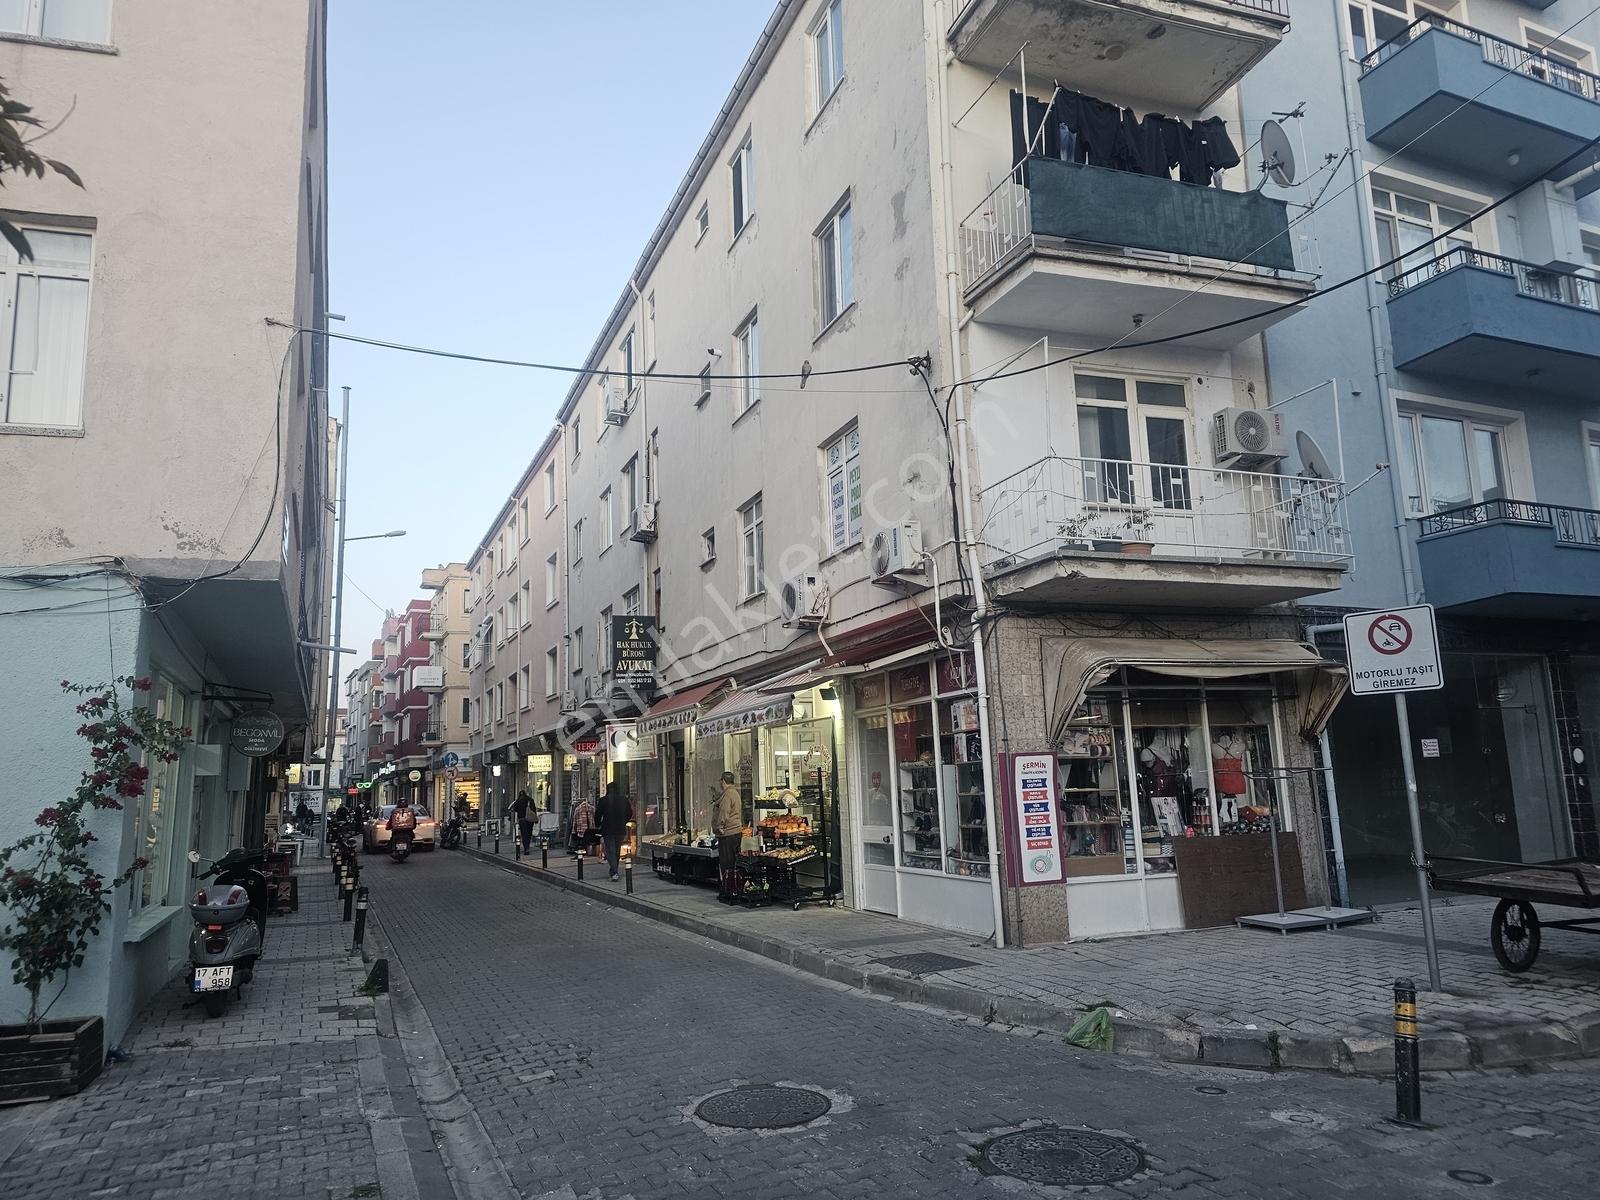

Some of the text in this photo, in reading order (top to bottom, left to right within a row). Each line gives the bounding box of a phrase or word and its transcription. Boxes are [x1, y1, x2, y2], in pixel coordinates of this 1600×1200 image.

[616, 641, 652, 649] HAK HUKUK
[622, 649, 646, 658] BÜROSU
[616, 660, 653, 671] AVUKAT
[1355, 665, 1434, 680] MOTORLU TAŞIT
[1372, 678, 1416, 688] GİREMEZ
[1022, 760, 1046, 770] ŞERMİN
[198, 967, 232, 977] 17 AFT
[211, 977, 231, 988] 958
